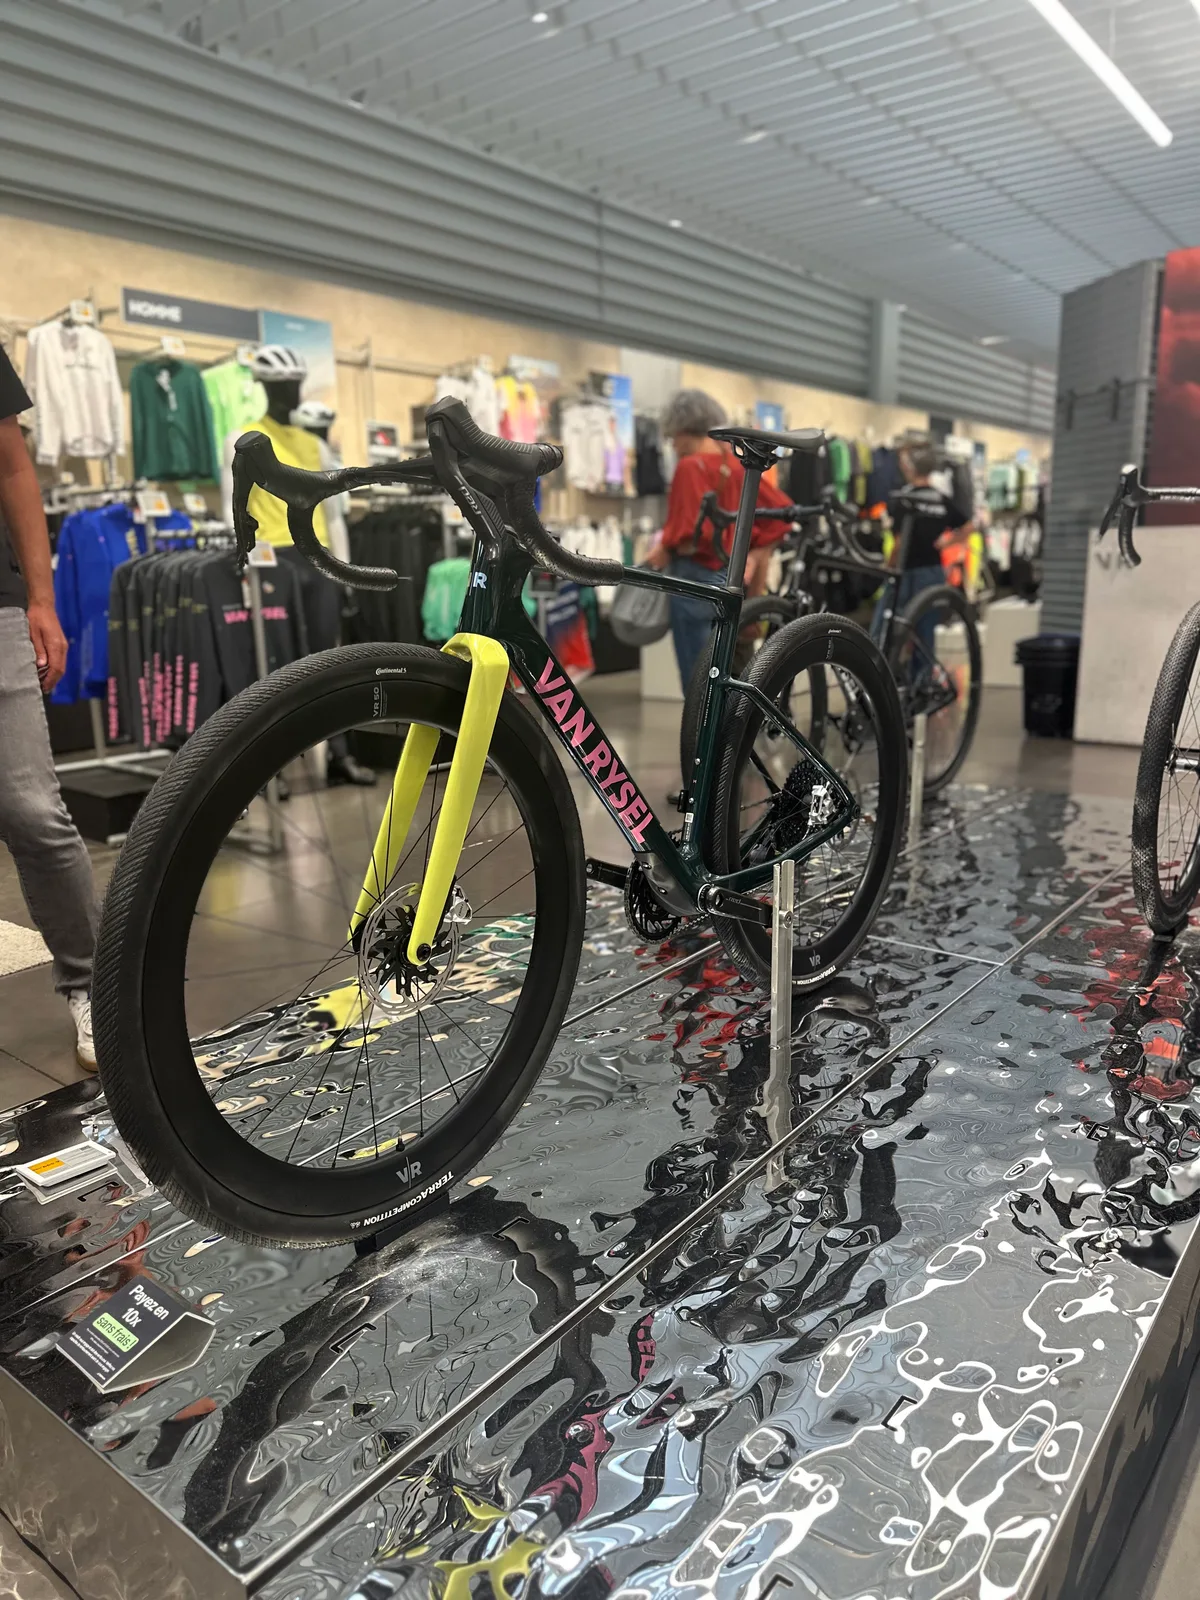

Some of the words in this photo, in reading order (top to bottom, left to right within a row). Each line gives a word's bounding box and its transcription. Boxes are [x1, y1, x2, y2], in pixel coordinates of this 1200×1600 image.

[533, 657, 596, 748] VAN
[582, 739, 654, 845] RYSEL
[129, 1284, 158, 1312] Payez
[153, 1306, 170, 1321] en
[96, 1316, 113, 1334] sans
[122, 1307, 142, 1328] 10x
